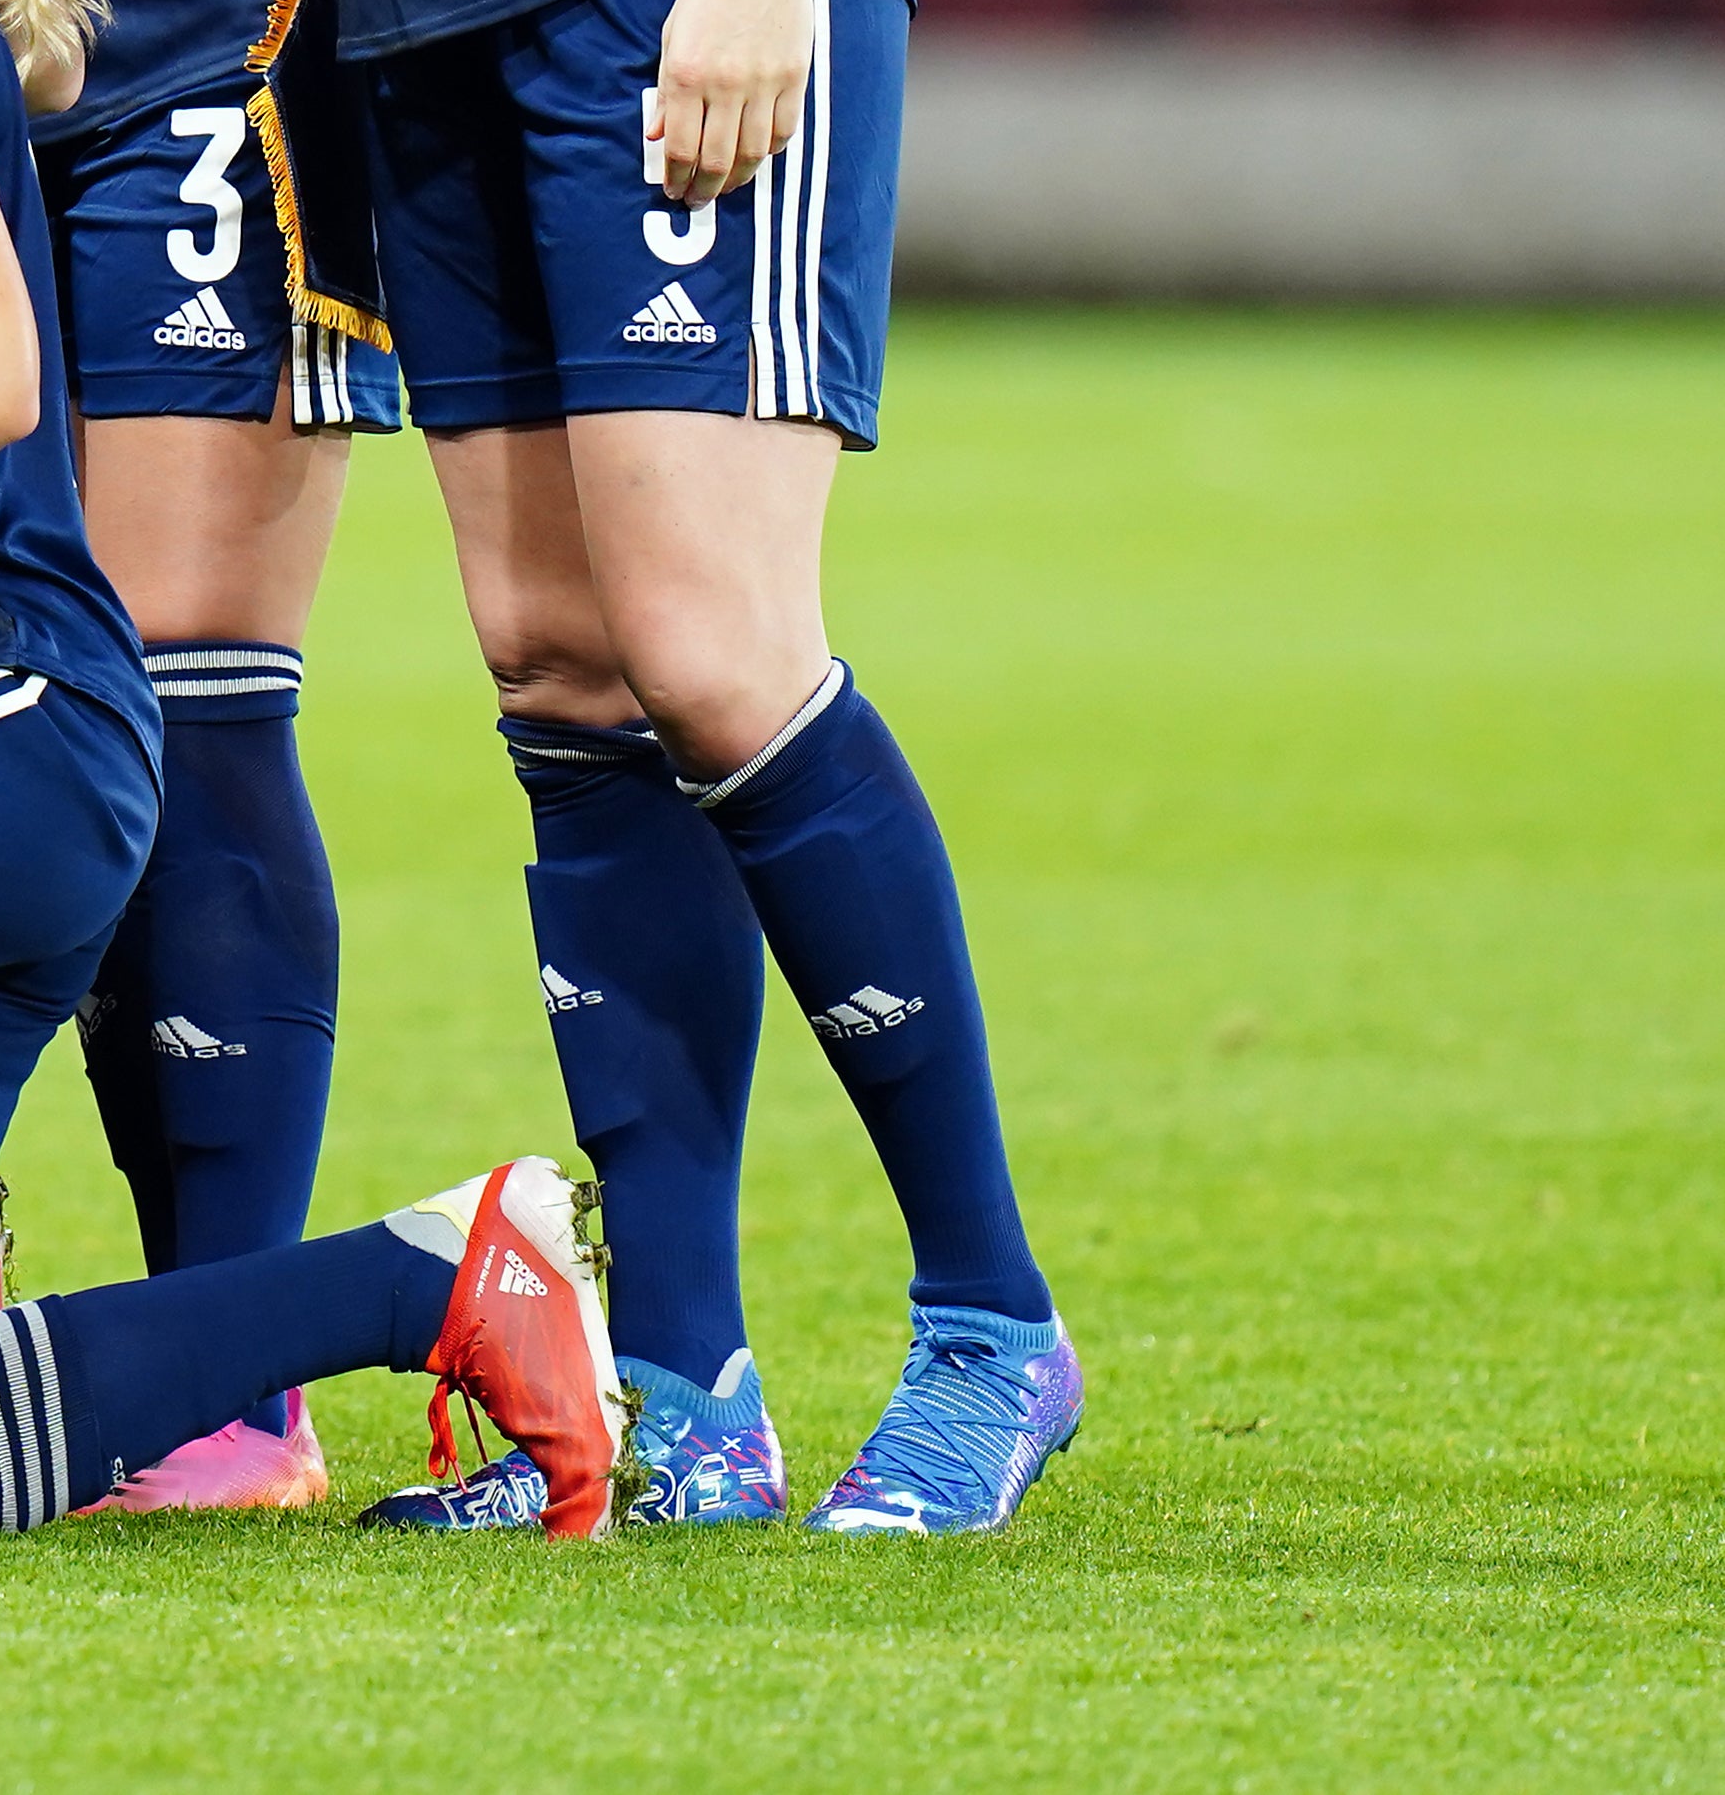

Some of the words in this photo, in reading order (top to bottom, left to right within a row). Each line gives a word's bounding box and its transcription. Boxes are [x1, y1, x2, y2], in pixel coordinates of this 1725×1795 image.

[165, 107, 247, 284] 3
[153, 322, 247, 352] adidas
[622, 317, 718, 345] adidas
[504, 1249, 549, 1297] adidas
